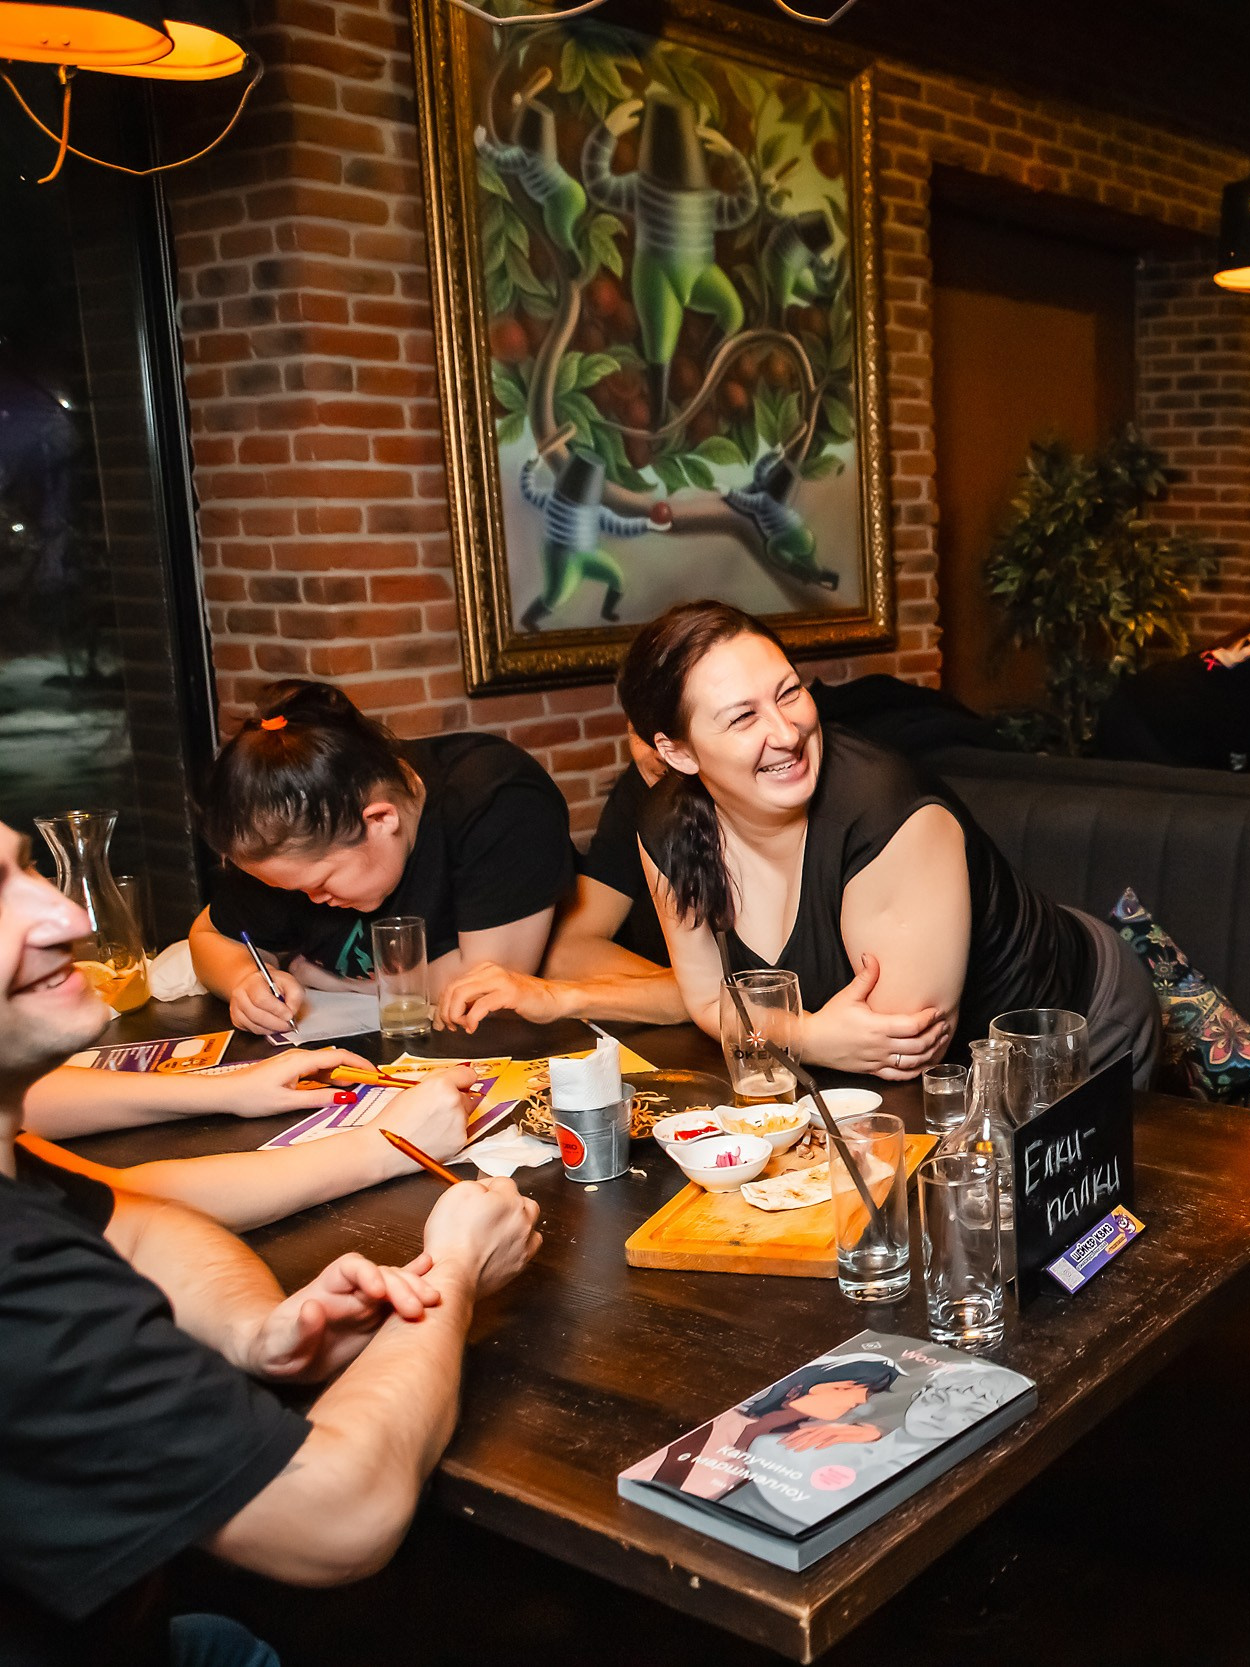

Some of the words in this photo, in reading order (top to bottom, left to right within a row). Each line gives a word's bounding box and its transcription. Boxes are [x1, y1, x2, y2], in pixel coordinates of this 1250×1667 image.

[1046, 1155, 1121, 1236] палки
[1071, 1237, 1097, 1262] ШЕЙКЕР
[1093, 1223, 1114, 1242] КВИЗ
[716, 1445, 803, 1480] Капучино
